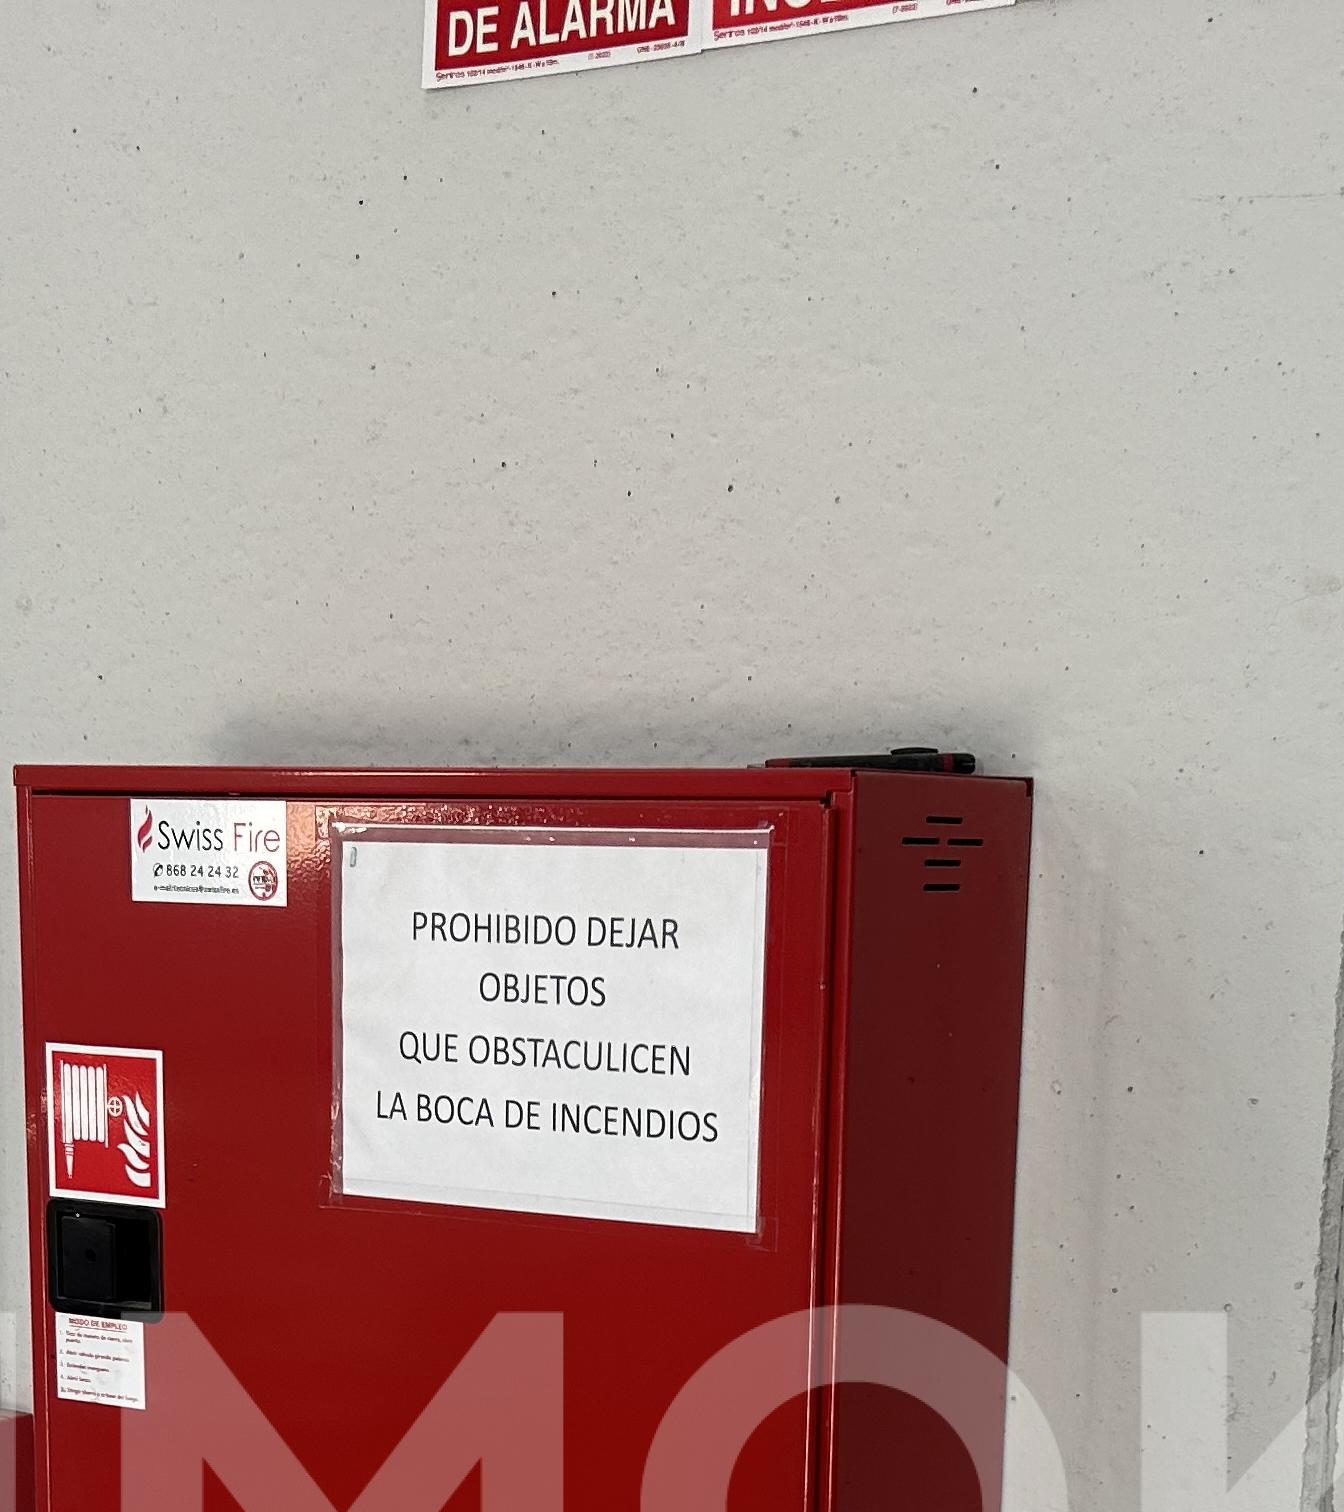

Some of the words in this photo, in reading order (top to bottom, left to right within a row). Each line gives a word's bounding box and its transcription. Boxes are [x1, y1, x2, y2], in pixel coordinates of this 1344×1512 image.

[448, 6, 499, 57] DE
[510, 0, 676, 50] ALARMA
[157, 820, 224, 851] Swiss
[233, 821, 281, 853] Fire
[166, 864, 187, 877] 868
[190, 864, 204, 877] 24
[207, 865, 222, 878] 24
[224, 866, 240, 878] 32
[412, 911, 577, 946] PROHIBIDO
[587, 916, 680, 949] DEJAR
[479, 971, 607, 1007] OBJETOS
[398, 1030, 459, 1066] QUE
[468, 1034, 691, 1077] OBSTACULICEN
[376, 1090, 408, 1122] LA
[416, 1093, 495, 1128] BOCA
[504, 1100, 541, 1131] DE
[551, 1102, 720, 1143] INCENDIOS
